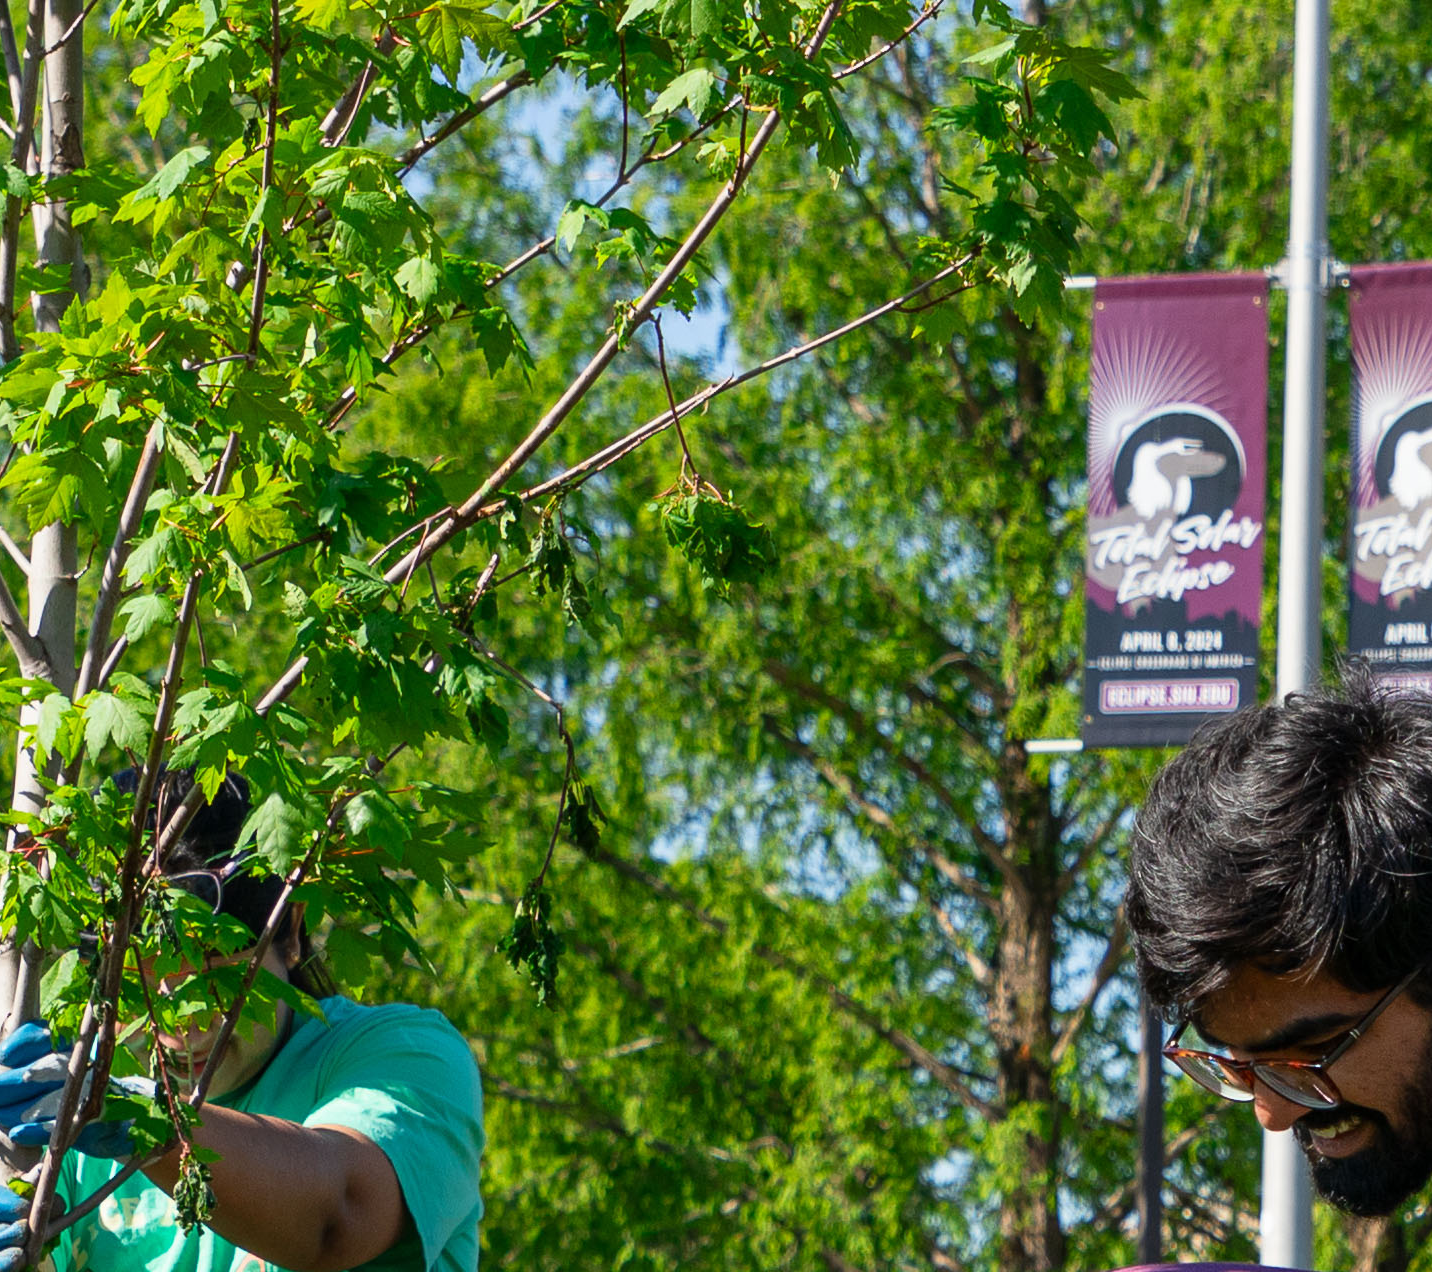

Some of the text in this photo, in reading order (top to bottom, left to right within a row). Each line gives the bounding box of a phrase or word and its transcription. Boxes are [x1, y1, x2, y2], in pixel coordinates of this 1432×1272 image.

[1090, 509, 1262, 570] Total Solar
[1116, 555, 1235, 604] Eclipse
[1120, 631, 1164, 652] APRIL
[1184, 629, 1223, 651] 2024
[1384, 623, 1428, 645] APRIL
